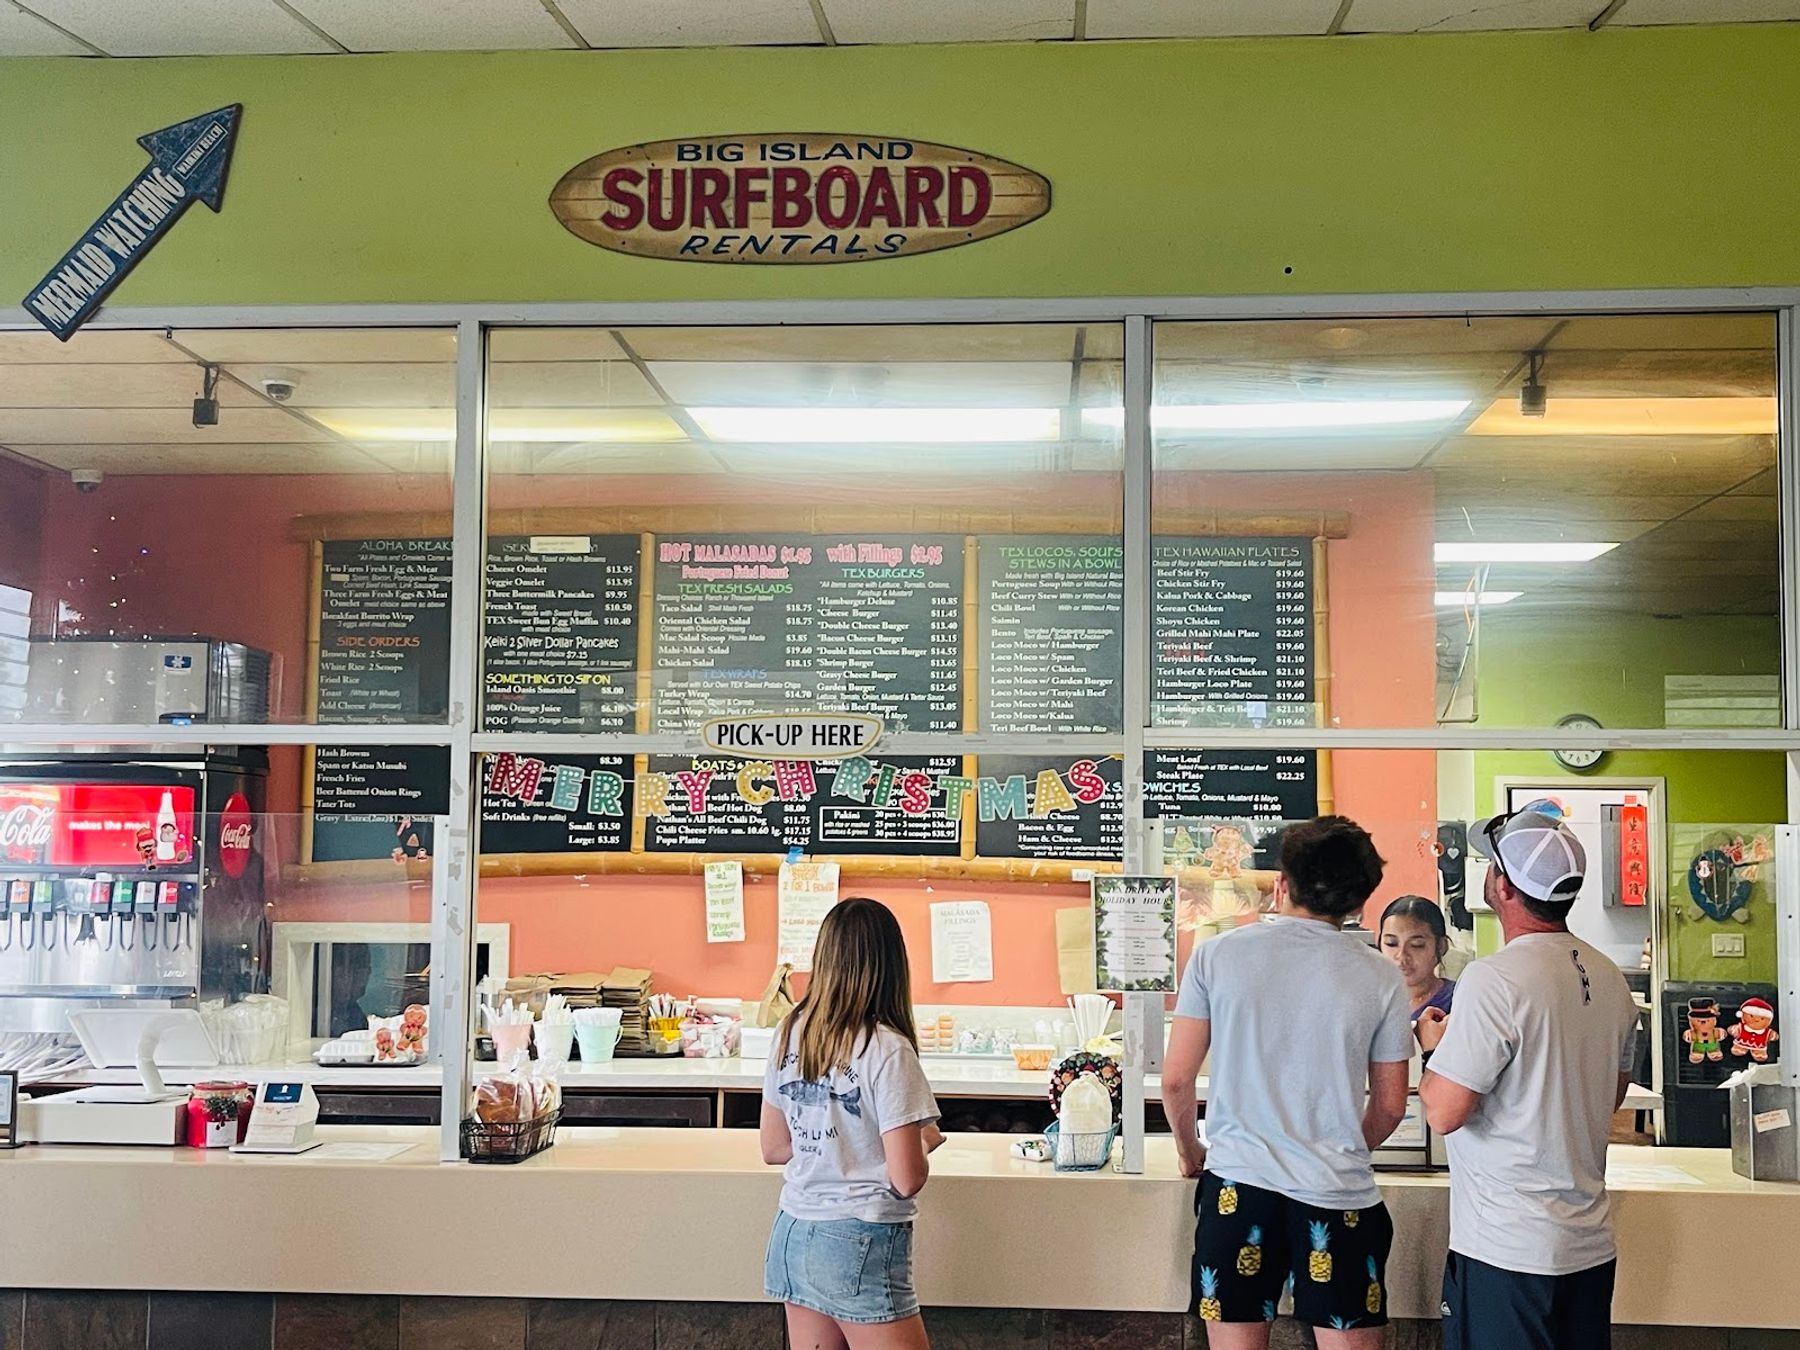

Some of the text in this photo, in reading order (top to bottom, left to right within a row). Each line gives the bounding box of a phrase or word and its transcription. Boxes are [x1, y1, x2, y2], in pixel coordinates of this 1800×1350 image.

[198, 125, 223, 150] BEACH
[676, 142, 914, 162] BIG ISLAND
[600, 165, 992, 231] SURFBOARD
[32, 167, 186, 330] MERMAID WATCHING
[680, 233, 908, 256] RENTALS
[360, 541, 403, 551] ALOHA
[660, 543, 692, 562] HOT
[694, 545, 776, 563] MALASADAS
[826, 544, 857, 562] with
[858, 544, 903, 568] Fillings
[1000, 547, 1025, 558] TEX
[1078, 547, 1123, 558] SOUPS
[1155, 548, 1300, 557] TEX HAWAIIAN PLATES
[324, 564, 438, 574] Two Farm Fresh Egg & Meat
[487, 565, 632, 573] Cheese Omelet $13.95
[1009, 559, 1122, 569] STEWS IN A BOWL
[841, 568, 926, 578] TEX BURGERS
[678, 584, 794, 594] TEX FRESH SALADS
[1156, 580, 1192, 588] Chicken
[1194, 580, 1210, 588] Stir
[1211, 580, 1226, 589] Fry
[486, 590, 628, 599] Three Buttermilk Pancakes $9.95
[992, 592, 1058, 601] Beef Curry Stew
[486, 602, 514, 610] French
[516, 602, 537, 610] Toast
[660, 604, 812, 612] Taco Salad $18.75
[322, 612, 414, 622] Breakfast Burrito Wrap
[658, 617, 812, 625] Oriental Chicken Salad $18.75
[992, 629, 1016, 637] Bento
[1156, 630, 1187, 638] Grilled
[1188, 630, 1212, 638] Mahi
[1213, 630, 1236, 638] Mahi
[1238, 630, 1260, 638] Plate
[336, 637, 420, 647] SIDE ORDERS
[484, 636, 620, 649] Keiki 2 Silver Dollar Pancakes
[486, 674, 611, 684] SOMETHING TO SIP ON
[816, 684, 956, 693] Garden Burger $12.45
[818, 703, 850, 712] Teriyaki
[851, 703, 871, 712] Beef
[870, 704, 898, 712] Burger
[716, 724, 864, 746] PICK-UP HERE
[318, 761, 340, 771] Spam
[352, 761, 374, 770] Katsu
[376, 761, 407, 770] Musubi
[692, 760, 736, 770] BOATS
[316, 774, 366, 782] French Fries
[1156, 772, 1304, 780] Steak Plate $22.25
[490, 752, 716, 817] MERRY
[316, 787, 422, 798] Beer Battered Onion Rings
[1158, 803, 1181, 811] Tuna
[482, 812, 530, 821] Soft Drinks
[68, 821, 103, 831] makes
[104, 820, 122, 831] the
[1018, 824, 1074, 833] Bacon & Egg
[656, 836, 809, 846] Pupu Platter $54.25
[1572, 949, 1591, 1002] PUMA
